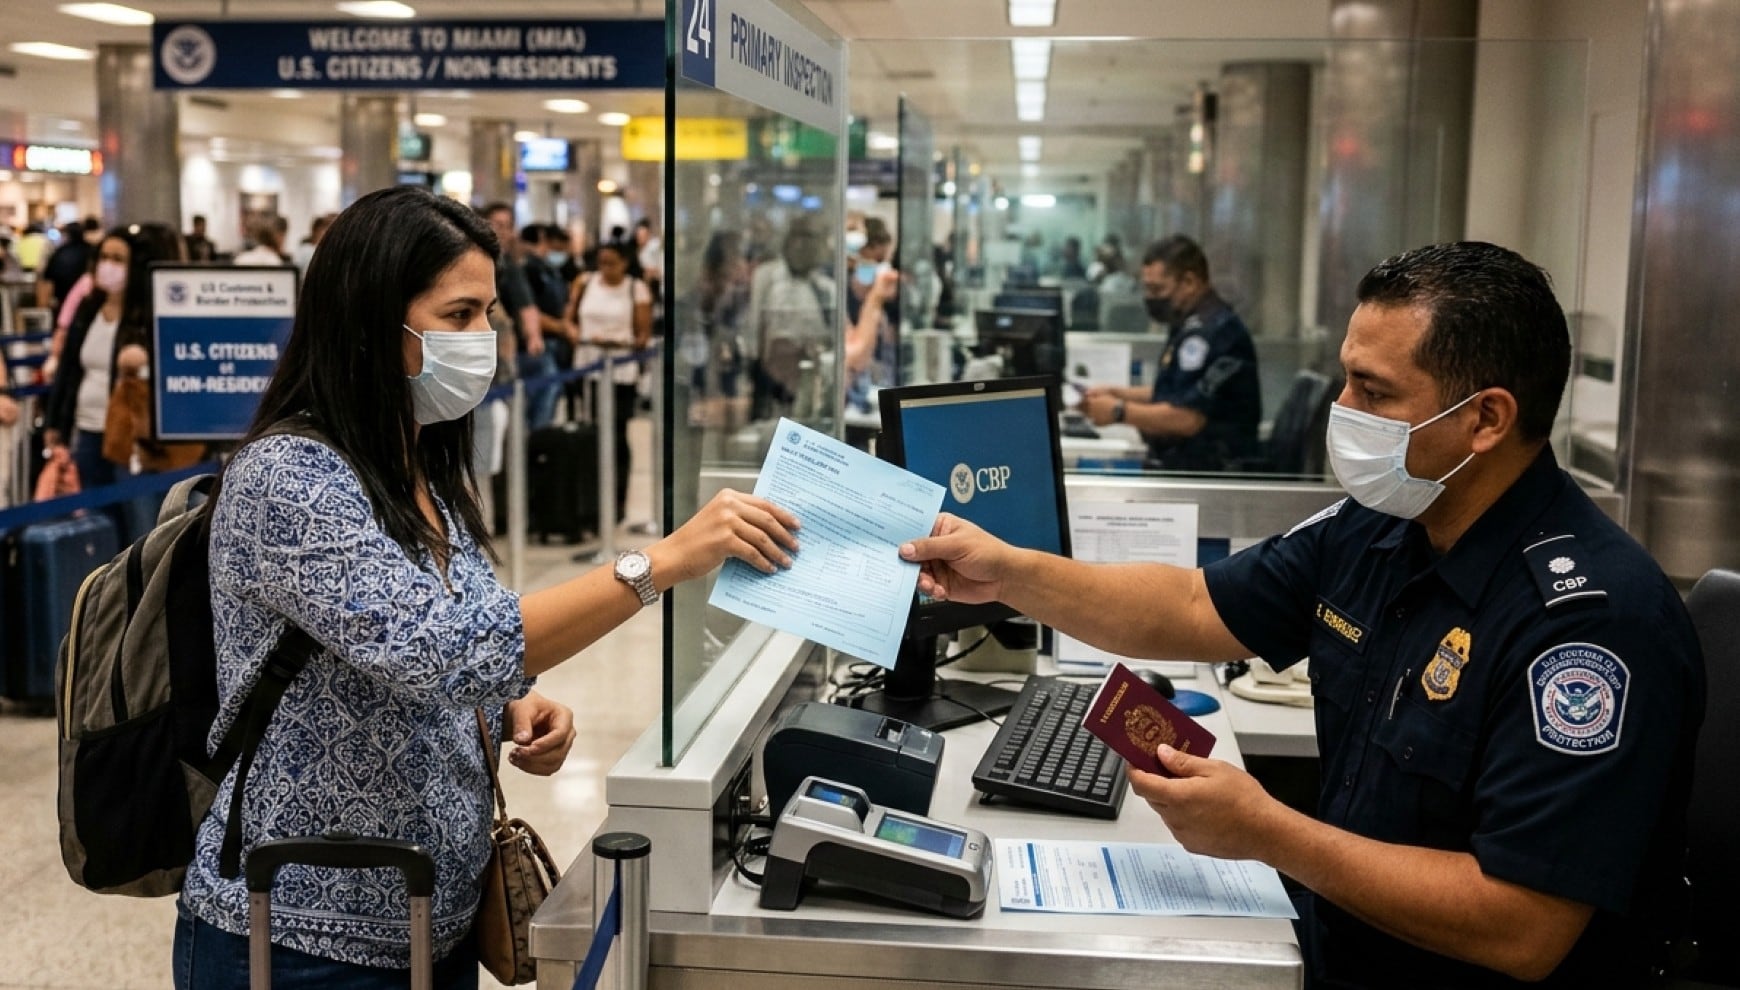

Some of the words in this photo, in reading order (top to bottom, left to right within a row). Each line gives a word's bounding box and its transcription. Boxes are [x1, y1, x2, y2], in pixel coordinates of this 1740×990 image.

[309, 27, 413, 51] WELCOME
[420, 27, 448, 51] TO
[453, 27, 522, 50] MIAMI
[525, 27, 587, 53] (MIA)
[686, 0, 712, 59] 24
[730, 12, 783, 82] PRIMARY
[277, 56, 322, 80] U.S.
[326, 56, 423, 80] CITIZENS
[444, 56, 618, 80] NON-RESIDENTS
[174, 342, 206, 361] U.S.
[208, 342, 279, 361] CITIZENS
[976, 465, 1011, 492] CBP
[1552, 576, 1588, 592] CBP
